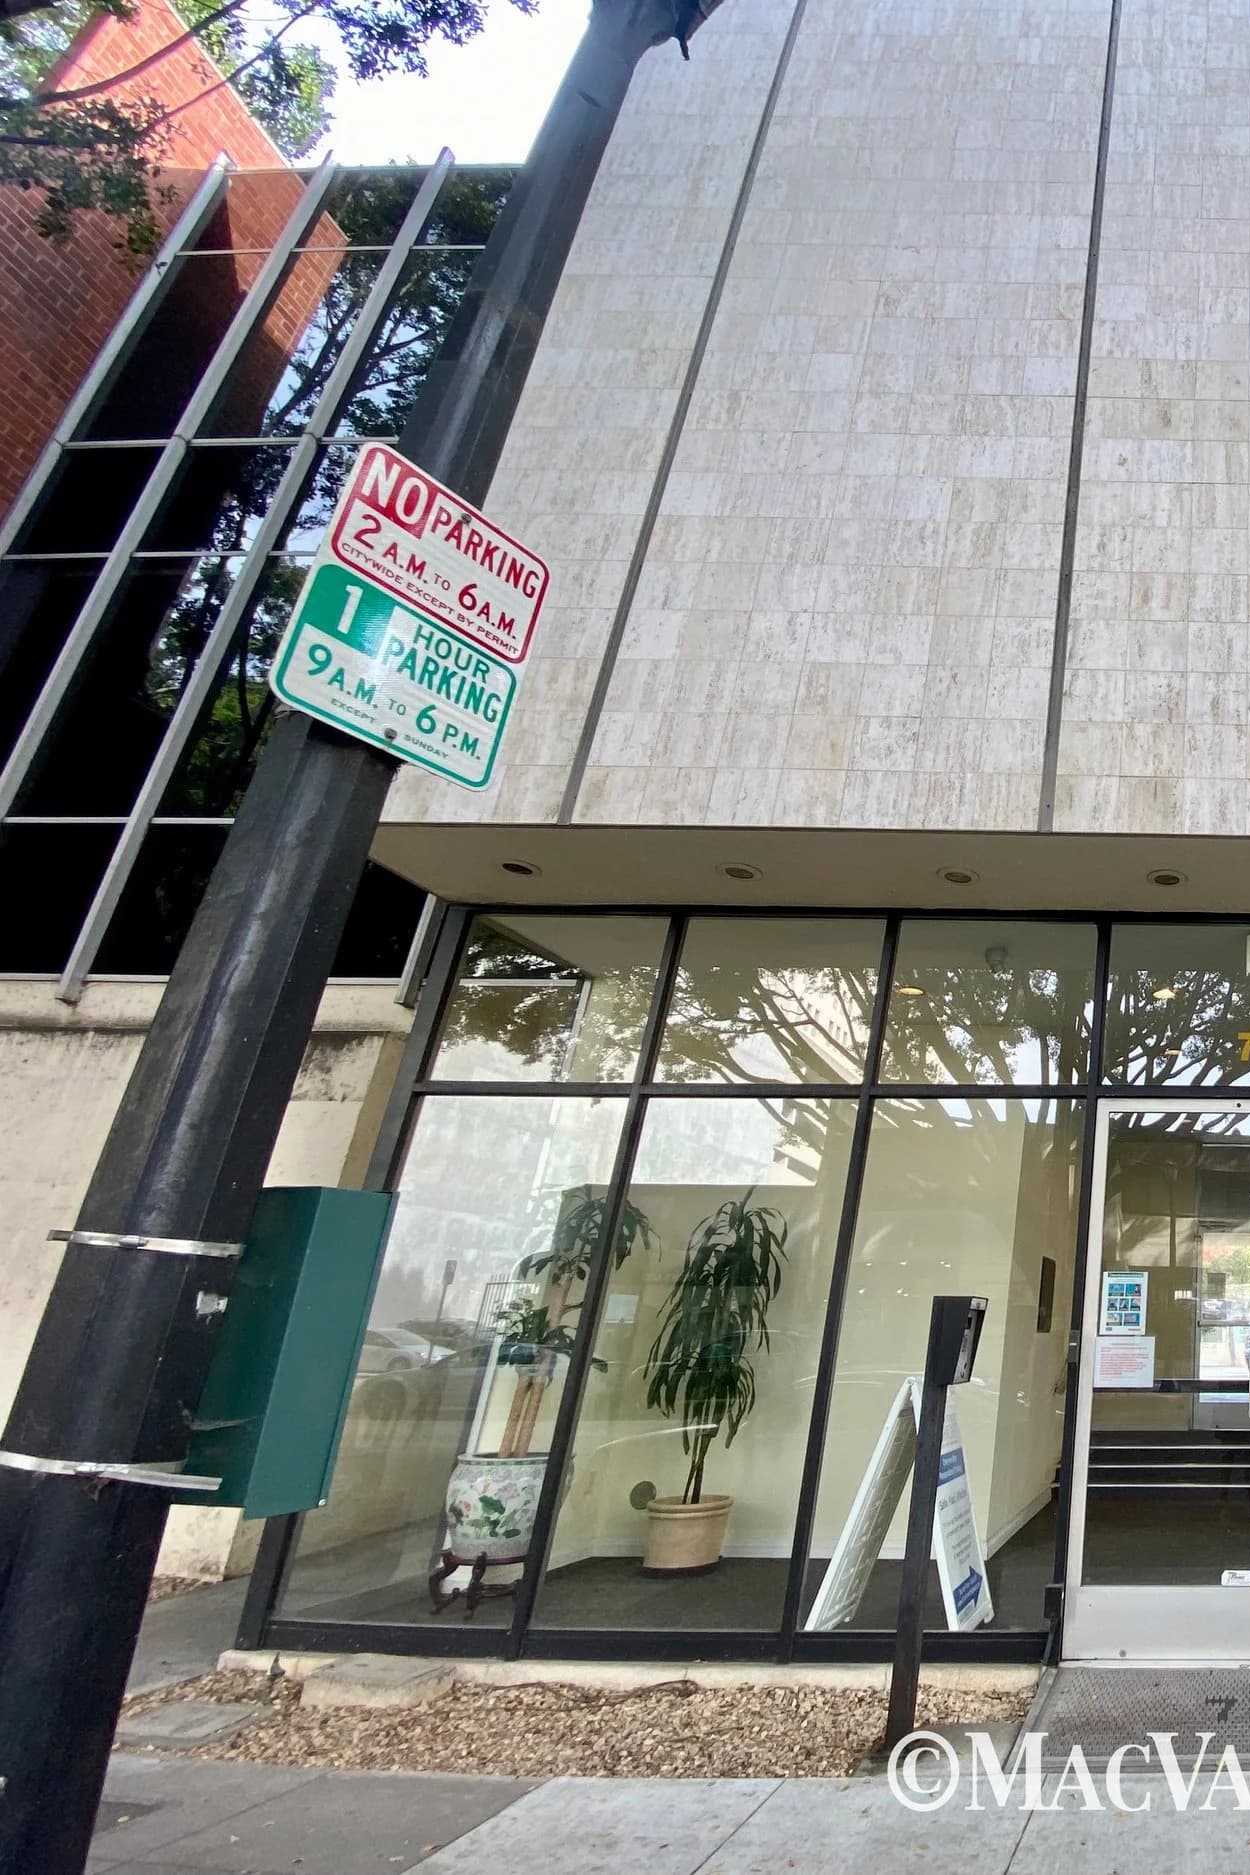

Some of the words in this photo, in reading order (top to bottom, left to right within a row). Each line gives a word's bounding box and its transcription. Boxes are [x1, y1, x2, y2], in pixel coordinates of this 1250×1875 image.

[353, 514, 382, 550] 2
[382, 542, 428, 584] A.M.
[434, 573, 451, 591] TO
[362, 452, 429, 525] NO
[431, 506, 539, 599] PARKING
[337, 584, 363, 635] 1
[413, 624, 490, 684] HOUR
[342, 542, 404, 585] CITYWIDE
[406, 582, 455, 615] EXCEPT
[456, 613, 474, 628] BY
[477, 626, 519, 655] PERMIT
[308, 644, 332, 676] 9
[388, 699, 407, 716] TO
[416, 704, 437, 735] 6
[442, 723, 481, 760] P.M.
[331, 698, 376, 725] EXCEPT
[403, 733, 450, 759] SUNDAY
[382, 636, 501, 723] PARKING
